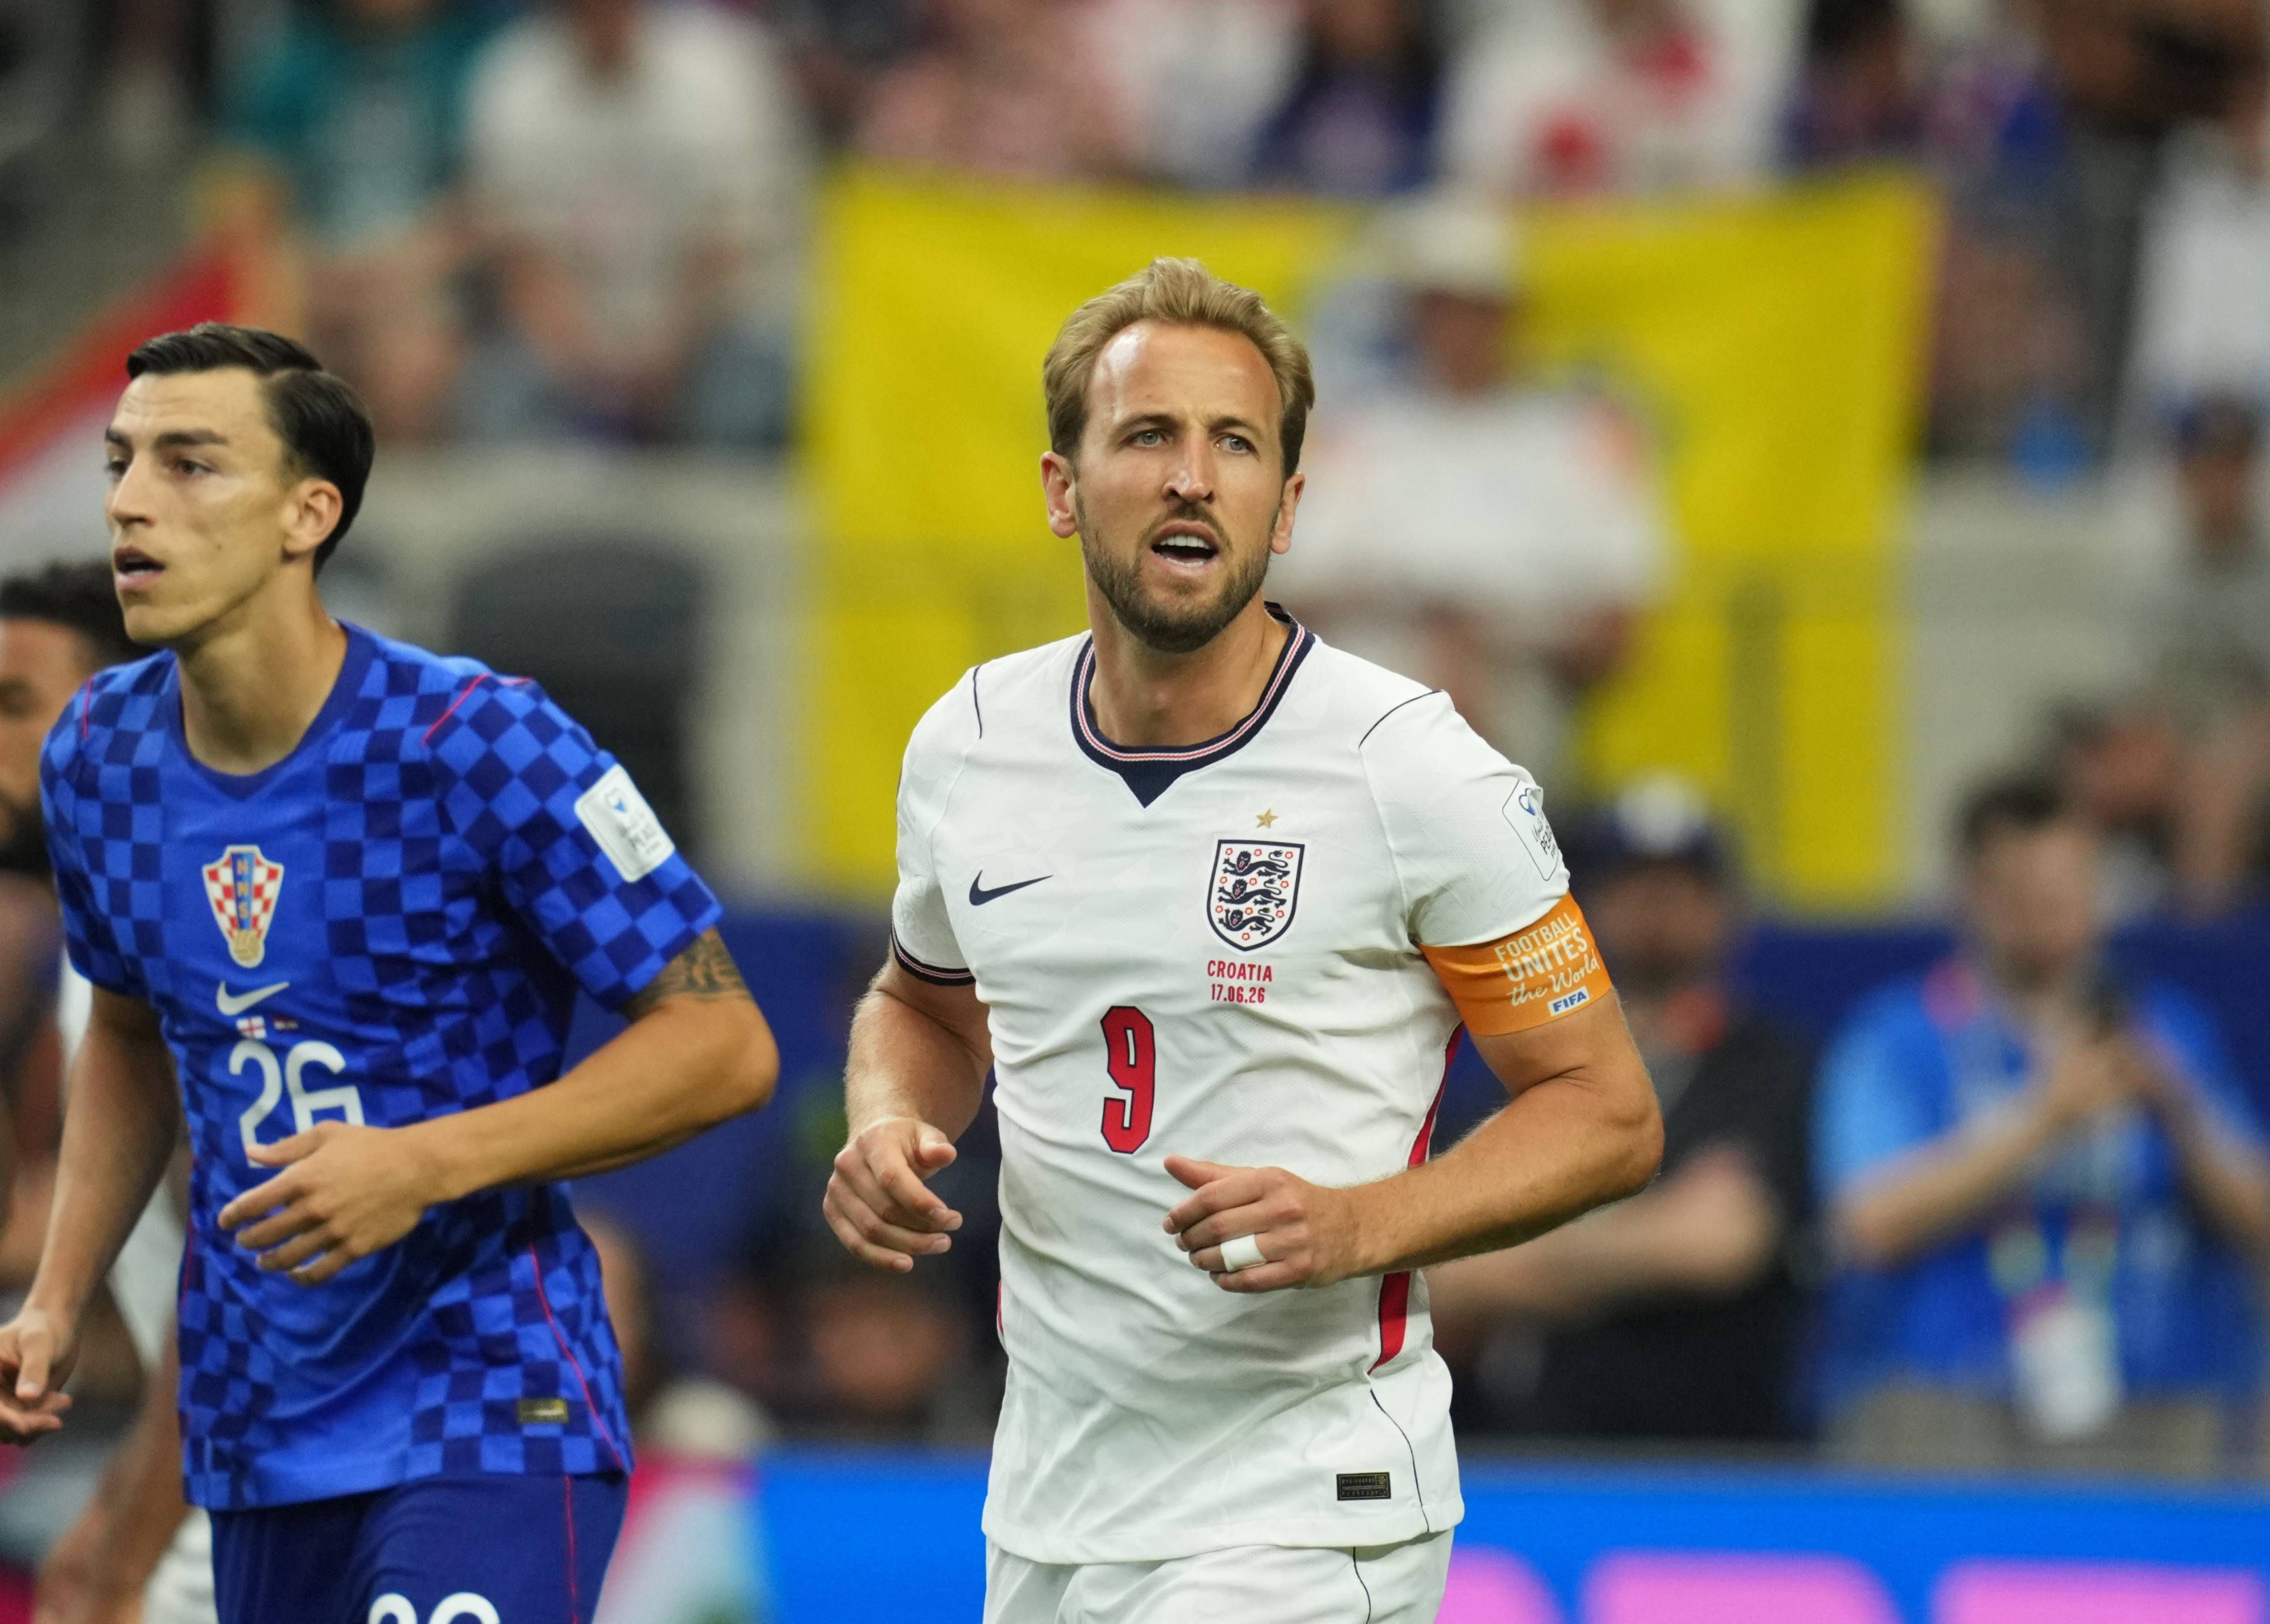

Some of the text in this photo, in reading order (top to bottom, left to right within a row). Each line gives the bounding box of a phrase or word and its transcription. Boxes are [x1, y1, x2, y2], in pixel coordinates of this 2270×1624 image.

[1495, 912, 1577, 962] FOOTBALL
[1502, 927, 1588, 983] UNITES
[1207, 959, 1272, 982] CROATIA
[1211, 983, 1266, 1003] 17.06.26
[1506, 948, 1600, 1007] the World
[1553, 991, 1587, 1013] FIFA
[228, 1038, 365, 1168] 26
[1100, 1005, 1156, 1155] 9
